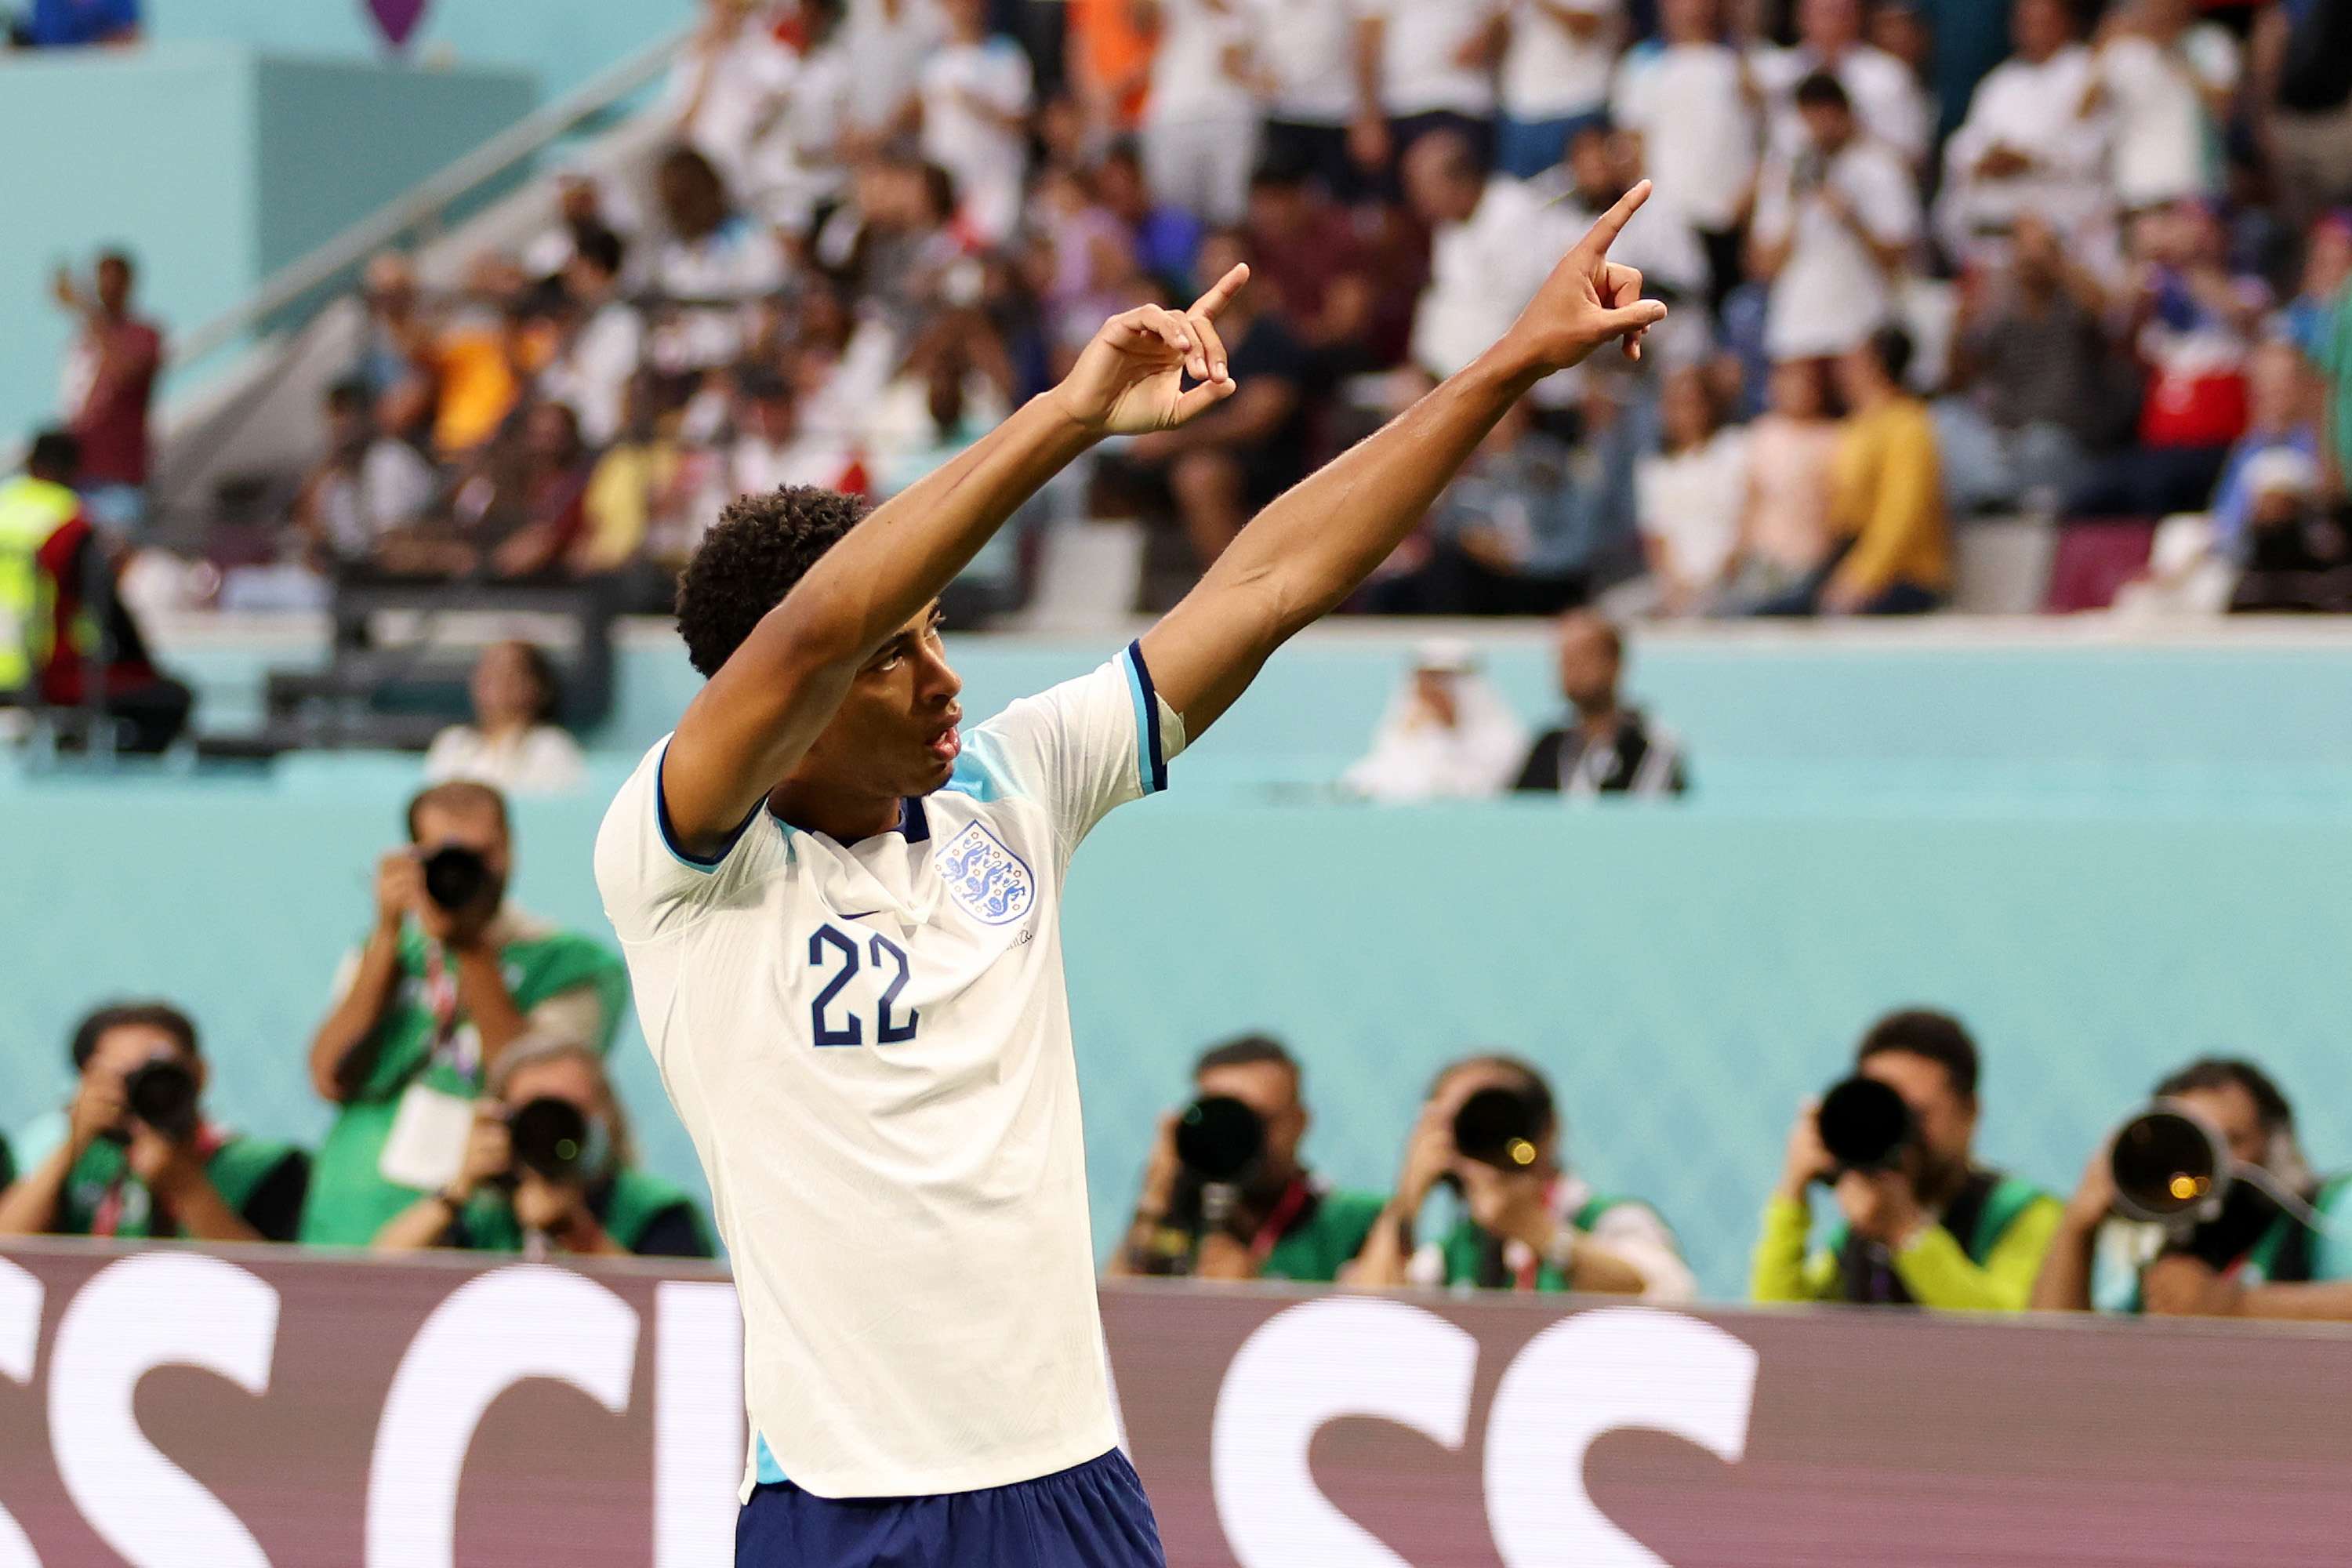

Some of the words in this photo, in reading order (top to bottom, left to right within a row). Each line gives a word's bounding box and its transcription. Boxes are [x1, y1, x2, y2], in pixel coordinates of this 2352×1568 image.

[809, 923, 920, 1047] 22
[0, 1251, 281, 1568] S
[365, 1262, 1759, 1568] CSS
